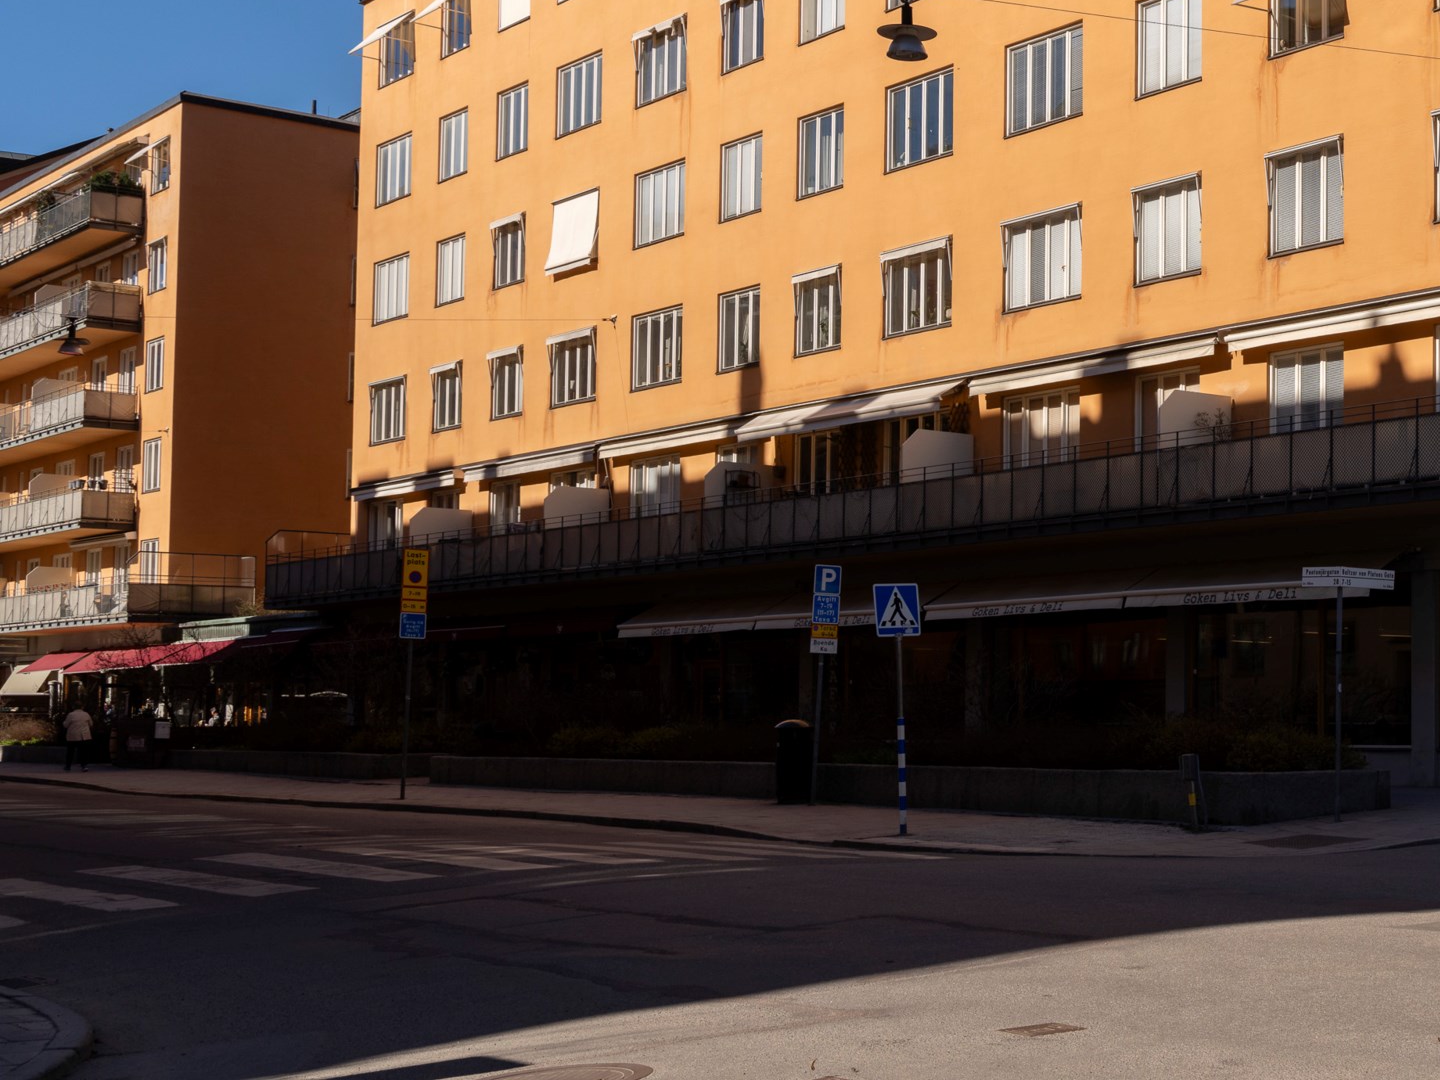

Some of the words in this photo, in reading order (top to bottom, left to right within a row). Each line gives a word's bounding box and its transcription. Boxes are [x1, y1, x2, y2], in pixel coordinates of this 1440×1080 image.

[821, 567, 837, 591] P
[817, 596, 837, 604] Avgift
[1222, 589, 1250, 602] Livs
[1268, 586, 1298, 600] Deli
[1003, 604, 1027, 615] Livs
[1039, 600, 1064, 612] Deli
[852, 616, 870, 624] Deli
